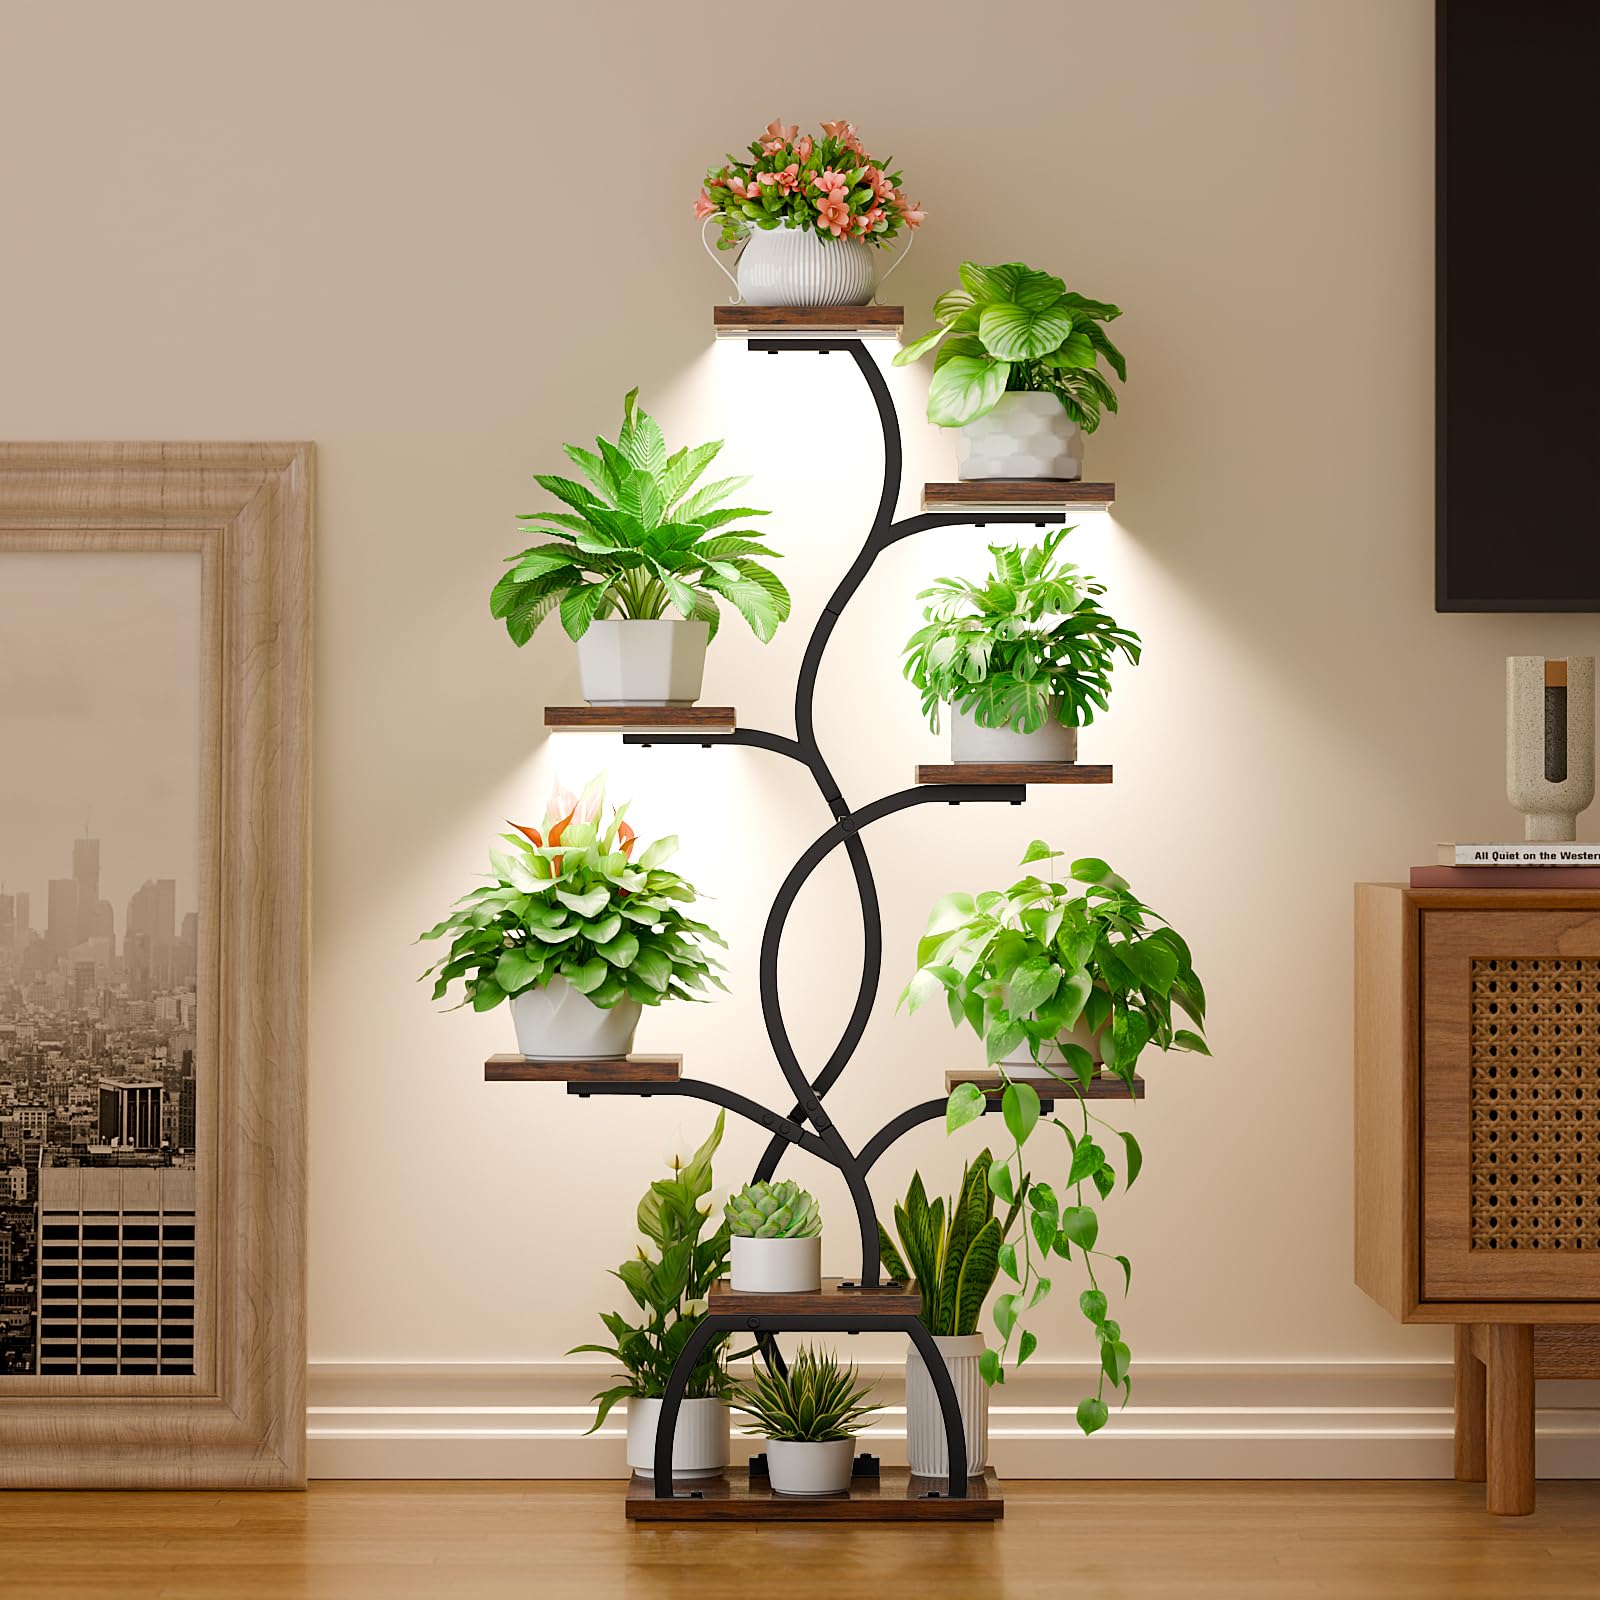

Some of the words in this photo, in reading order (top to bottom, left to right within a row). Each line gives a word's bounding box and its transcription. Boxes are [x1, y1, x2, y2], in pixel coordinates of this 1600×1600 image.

[1474, 851, 1489, 860] All
[1491, 851, 1520, 861] Quiet
[1539, 851, 1557, 860] the
[1560, 851, 1600, 860] Wester
